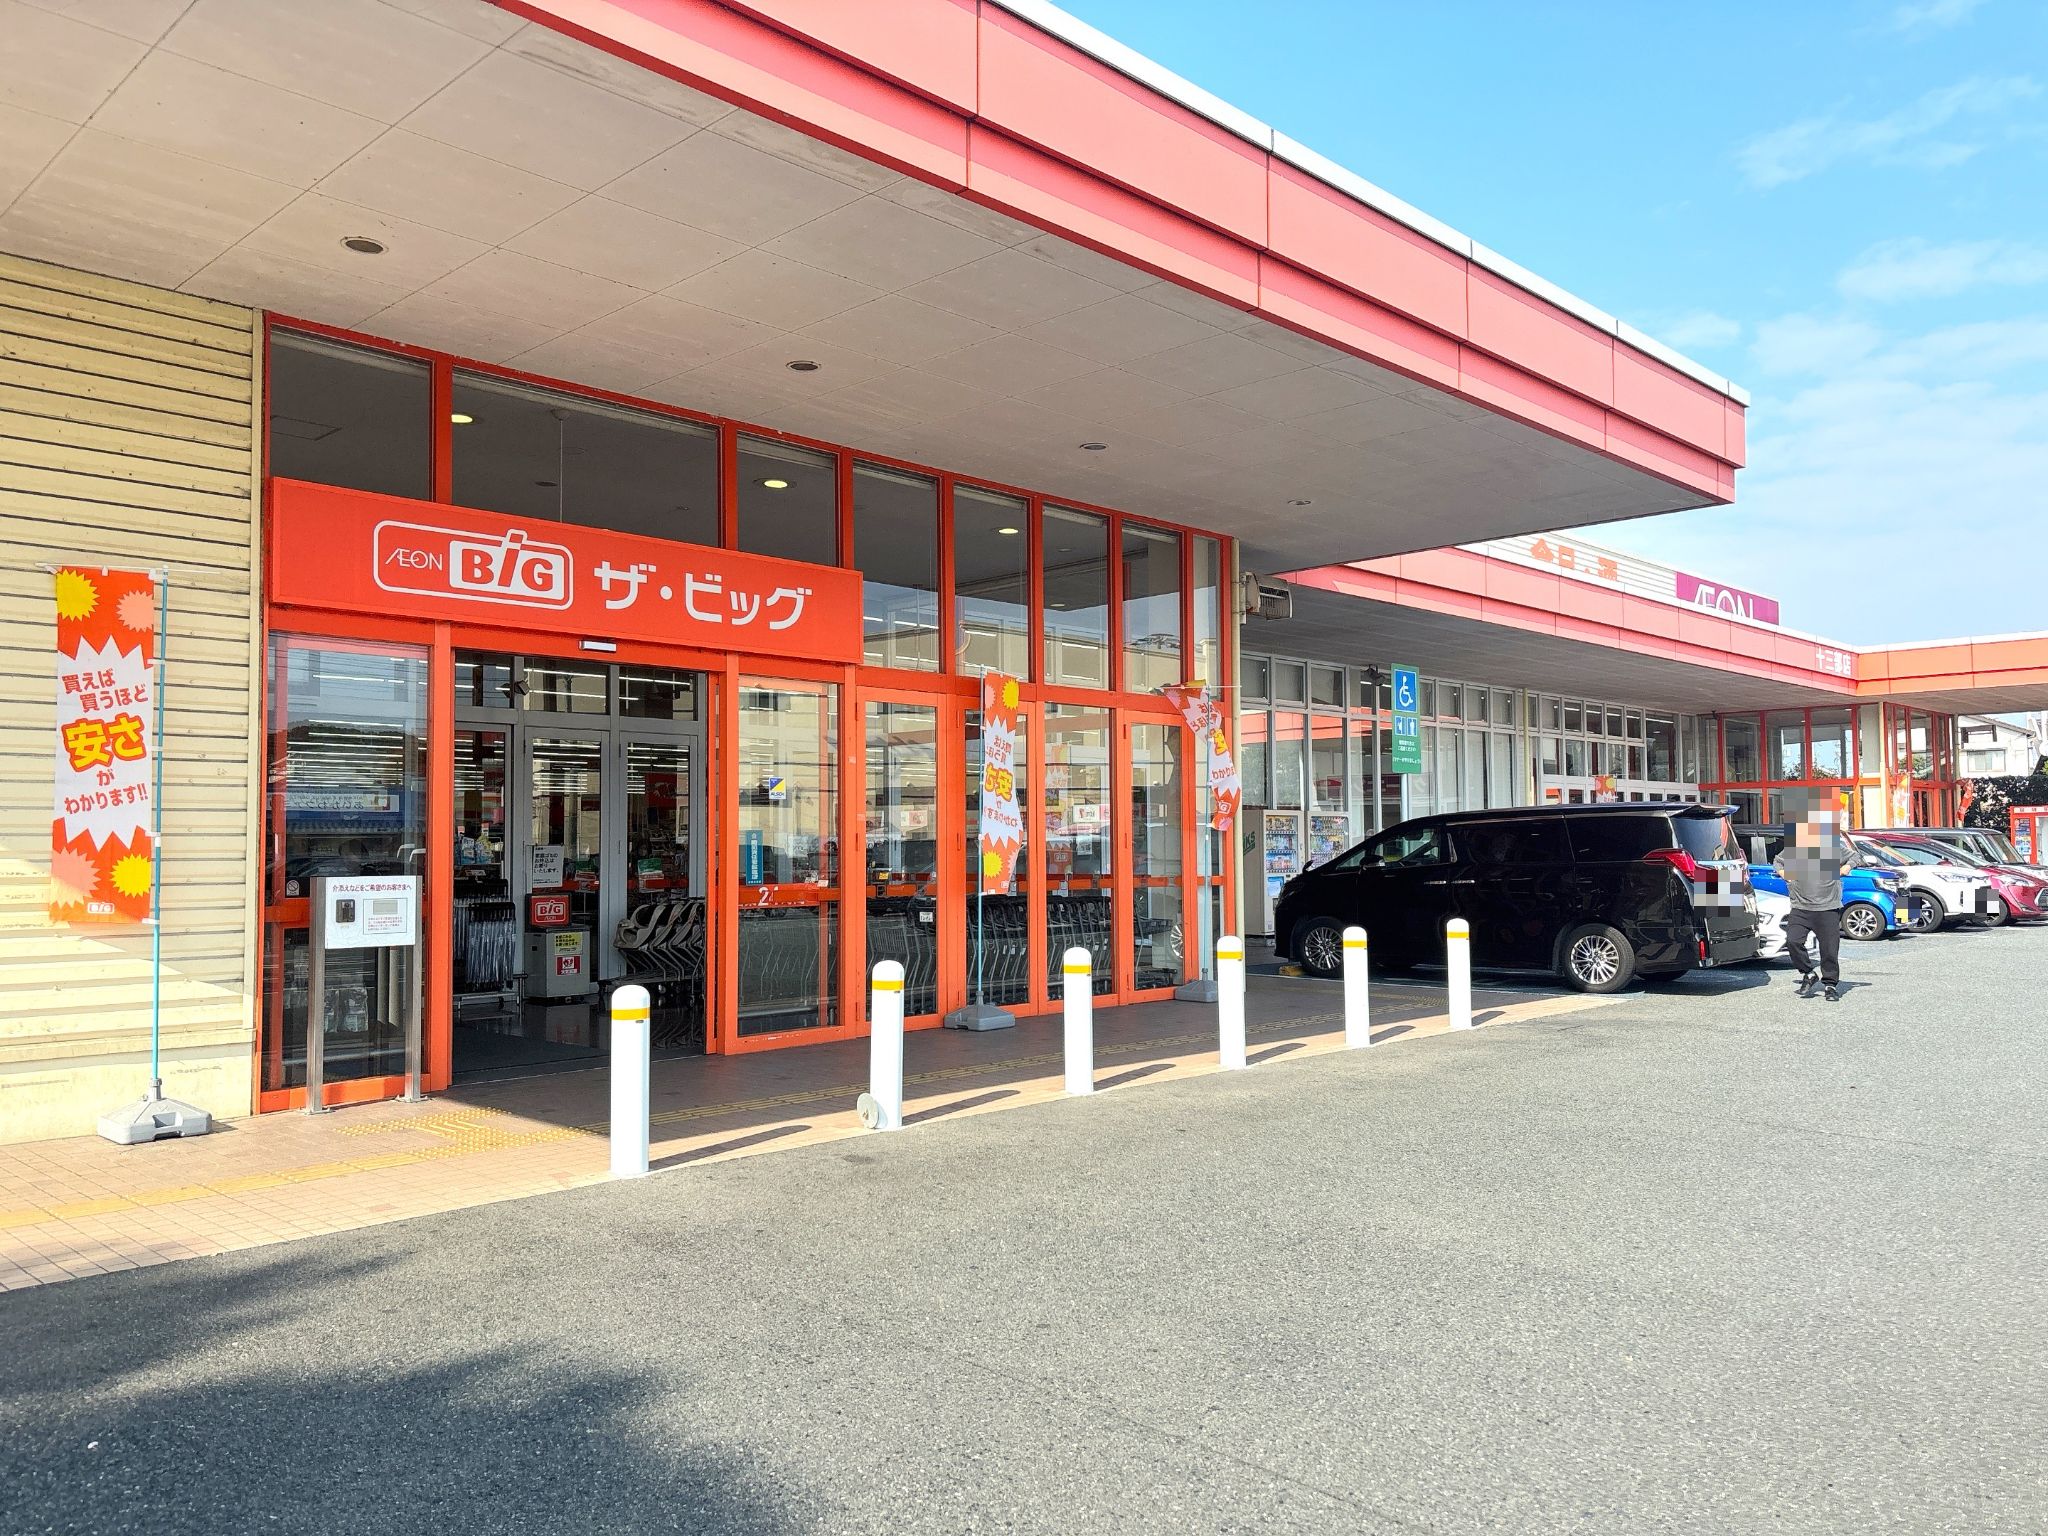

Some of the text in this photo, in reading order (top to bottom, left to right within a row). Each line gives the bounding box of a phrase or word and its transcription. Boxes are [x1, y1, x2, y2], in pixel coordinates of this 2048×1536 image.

[593, 560, 813, 631] ザ・ビッグ
[62, 668, 116, 694] 買えば
[80, 683, 148, 713] 買うほど
[61, 713, 146, 772] 安さ
[97, 769, 115, 786] が
[64, 783, 148, 815] わかります!!
